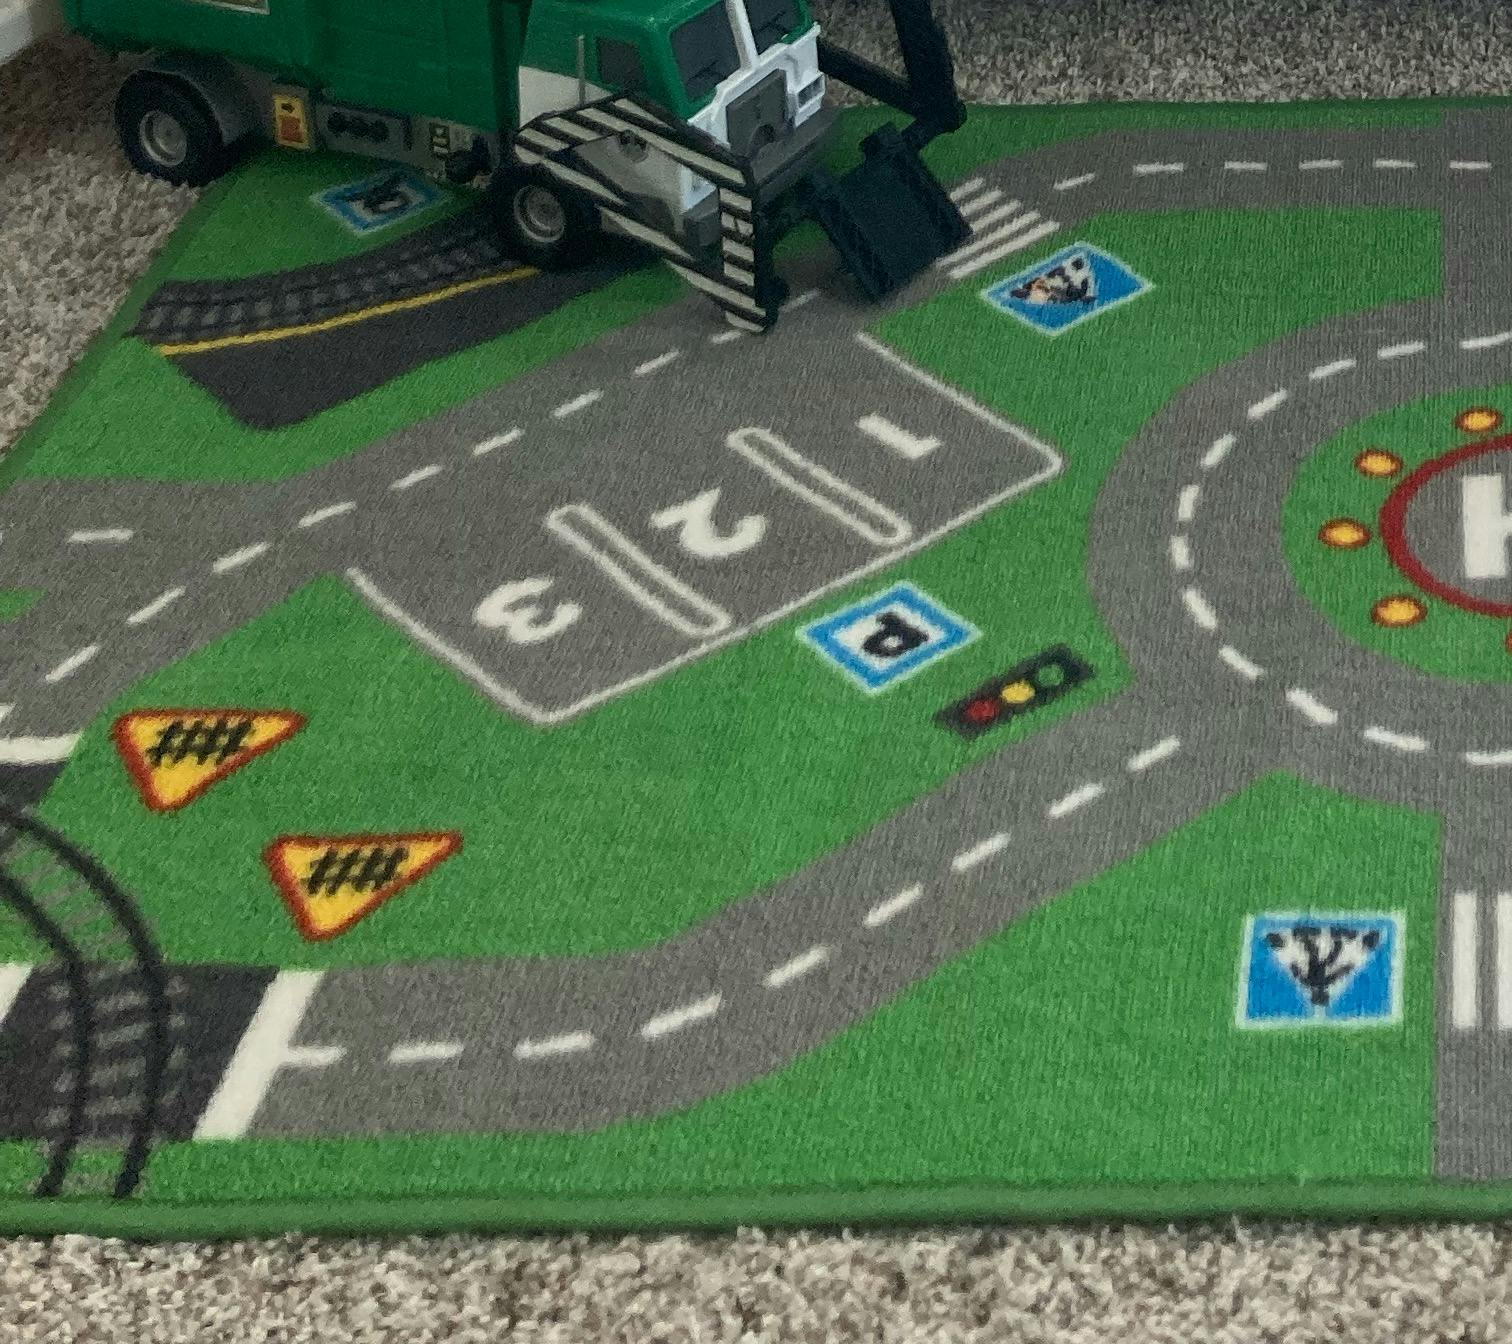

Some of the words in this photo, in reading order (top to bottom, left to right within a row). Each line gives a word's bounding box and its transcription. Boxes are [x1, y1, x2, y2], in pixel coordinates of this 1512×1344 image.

[857, 412, 942, 459] 1
[650, 487, 767, 558] 2
[473, 576, 583, 643] 3
